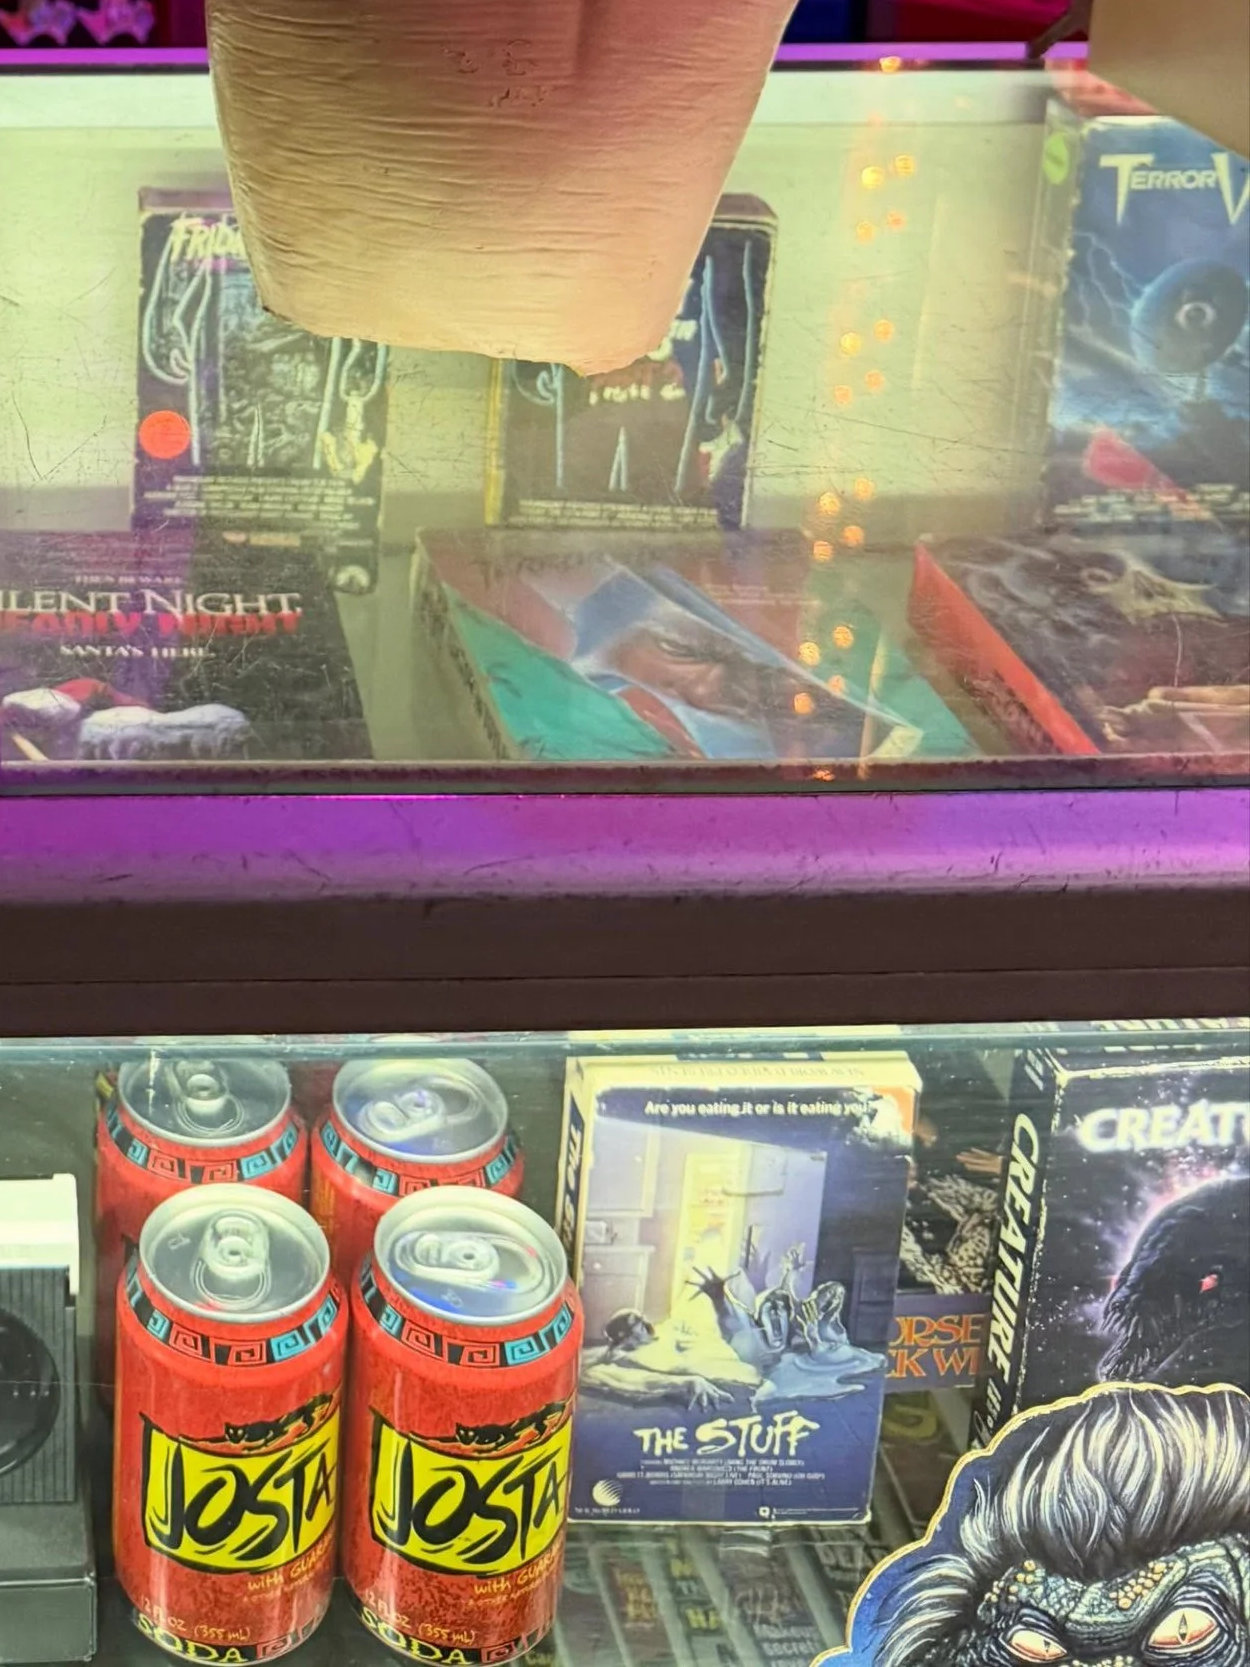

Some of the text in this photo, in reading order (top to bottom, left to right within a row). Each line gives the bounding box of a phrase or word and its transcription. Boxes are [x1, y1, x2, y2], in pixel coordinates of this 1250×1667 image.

[644, 1100, 670, 1115] Are
[671, 1103, 696, 1118] you
[697, 1100, 741, 1118] eating
[742, 1100, 753, 1115] it
[755, 1103, 771, 1115] or
[773, 1100, 785, 1115] is
[787, 1100, 799, 1115] it
[800, 1100, 842, 1118] eating
[1076, 1099, 1250, 1153] CREAT
[986, 1113, 1041, 1384] CREATURE
[633, 1410, 821, 1457] THE STUFF
[149, 1436, 339, 1565] JOSTA
[377, 1438, 565, 1566] JOSTA
[247, 1571, 284, 1591] with
[473, 1576, 511, 1595] with
[137, 1612, 250, 1664] SODA
[193, 1625, 225, 1641] (355
[361, 1605, 475, 1666] SODA
[417, 1622, 450, 1639] (355
